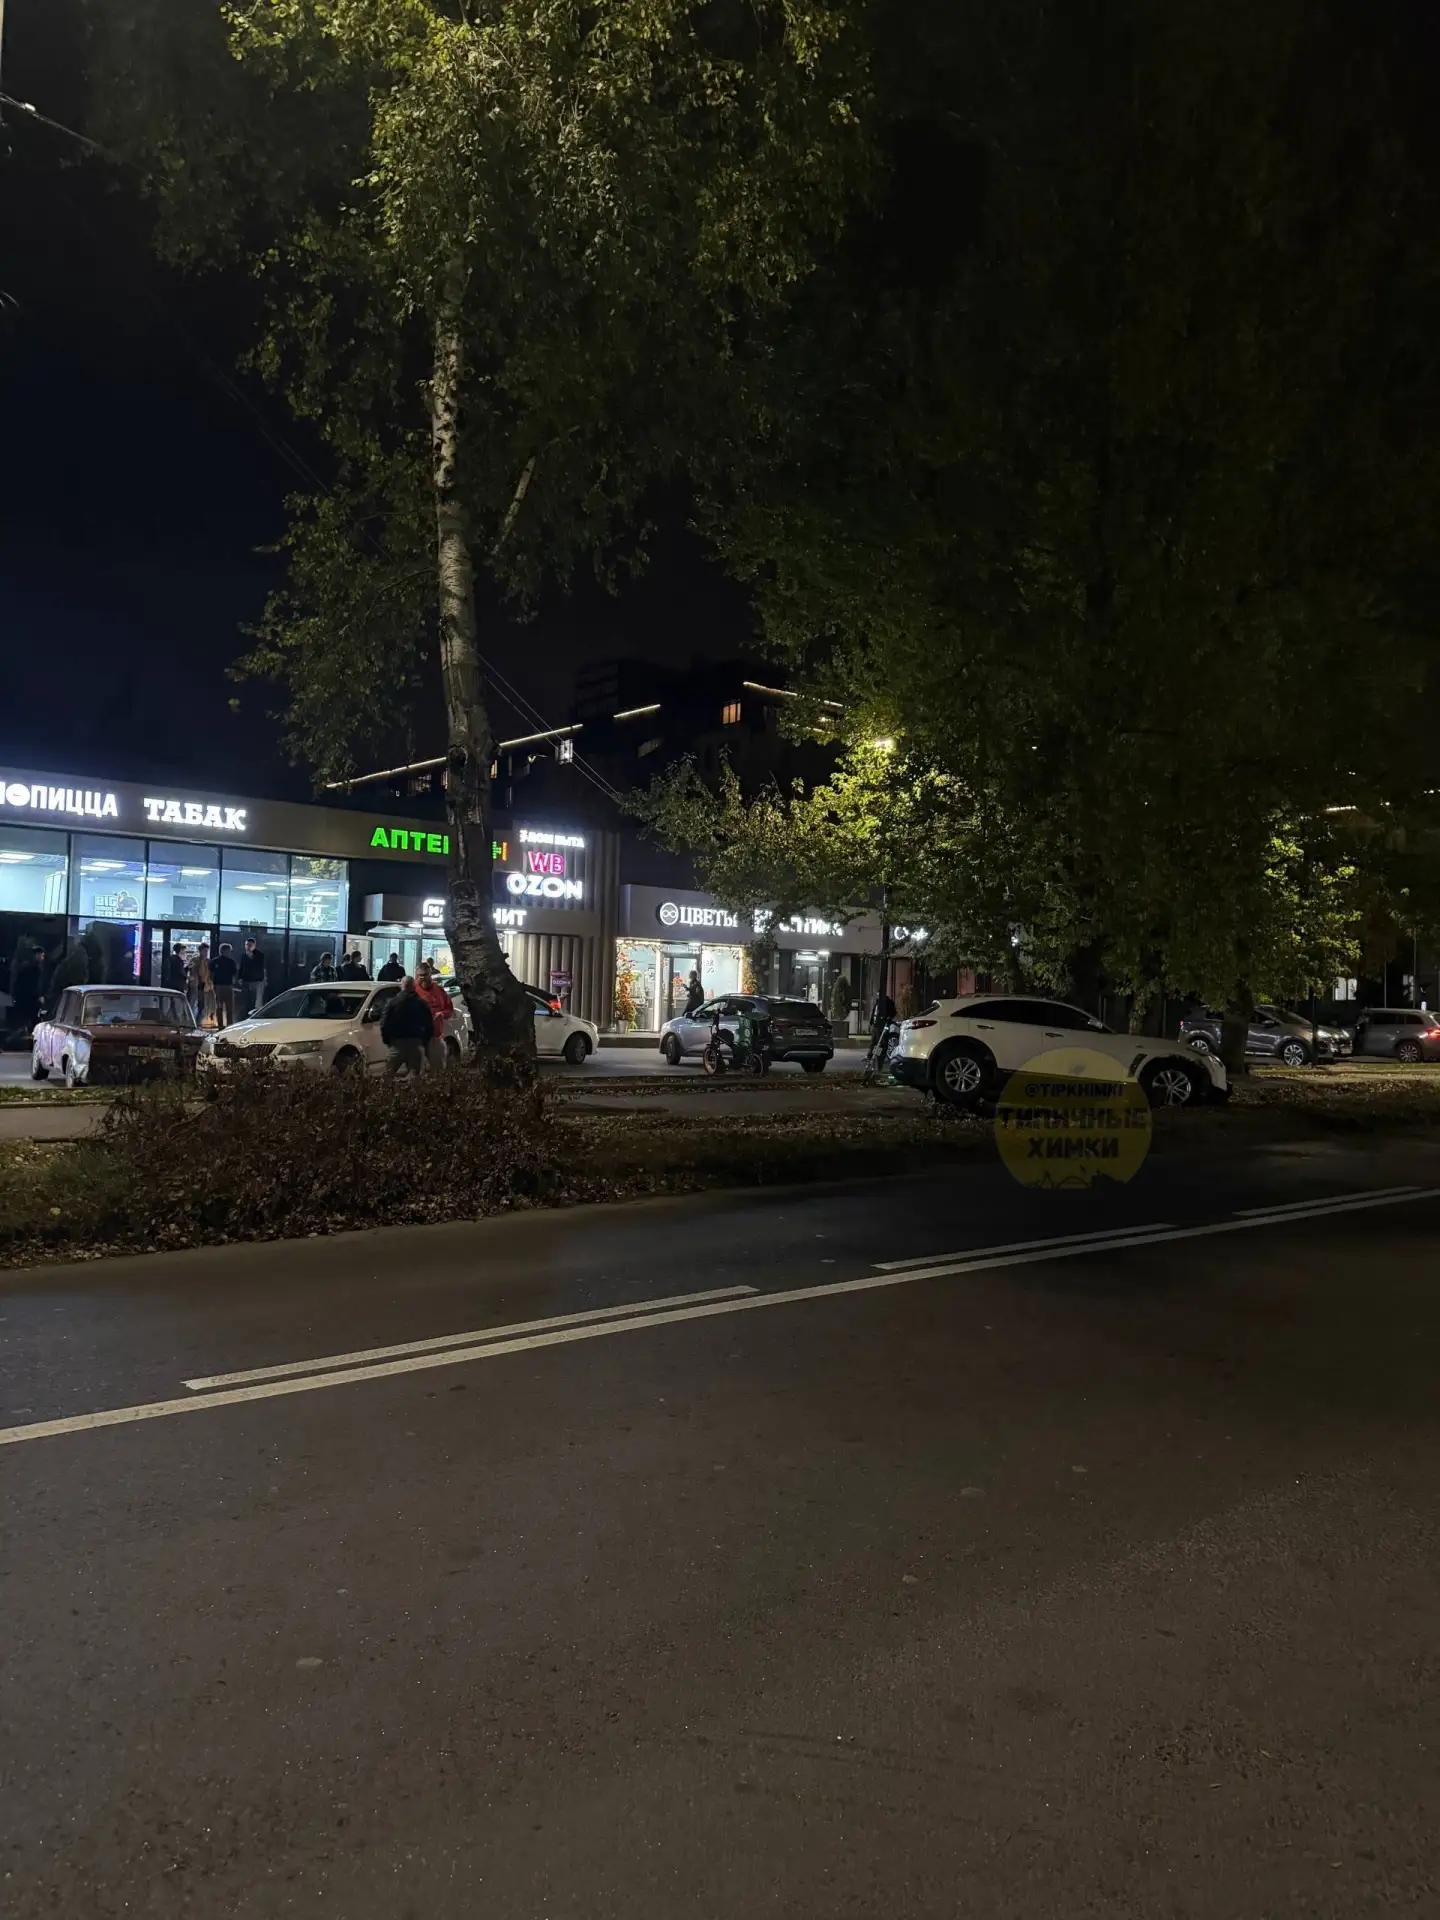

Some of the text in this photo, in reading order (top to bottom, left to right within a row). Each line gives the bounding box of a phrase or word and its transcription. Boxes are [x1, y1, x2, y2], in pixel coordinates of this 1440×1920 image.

[143, 797, 246, 831] ТАБАК
[527, 850, 565, 875] WB
[506, 872, 584, 900] OZON
[679, 906, 739, 928] ЦВЕТЫ
